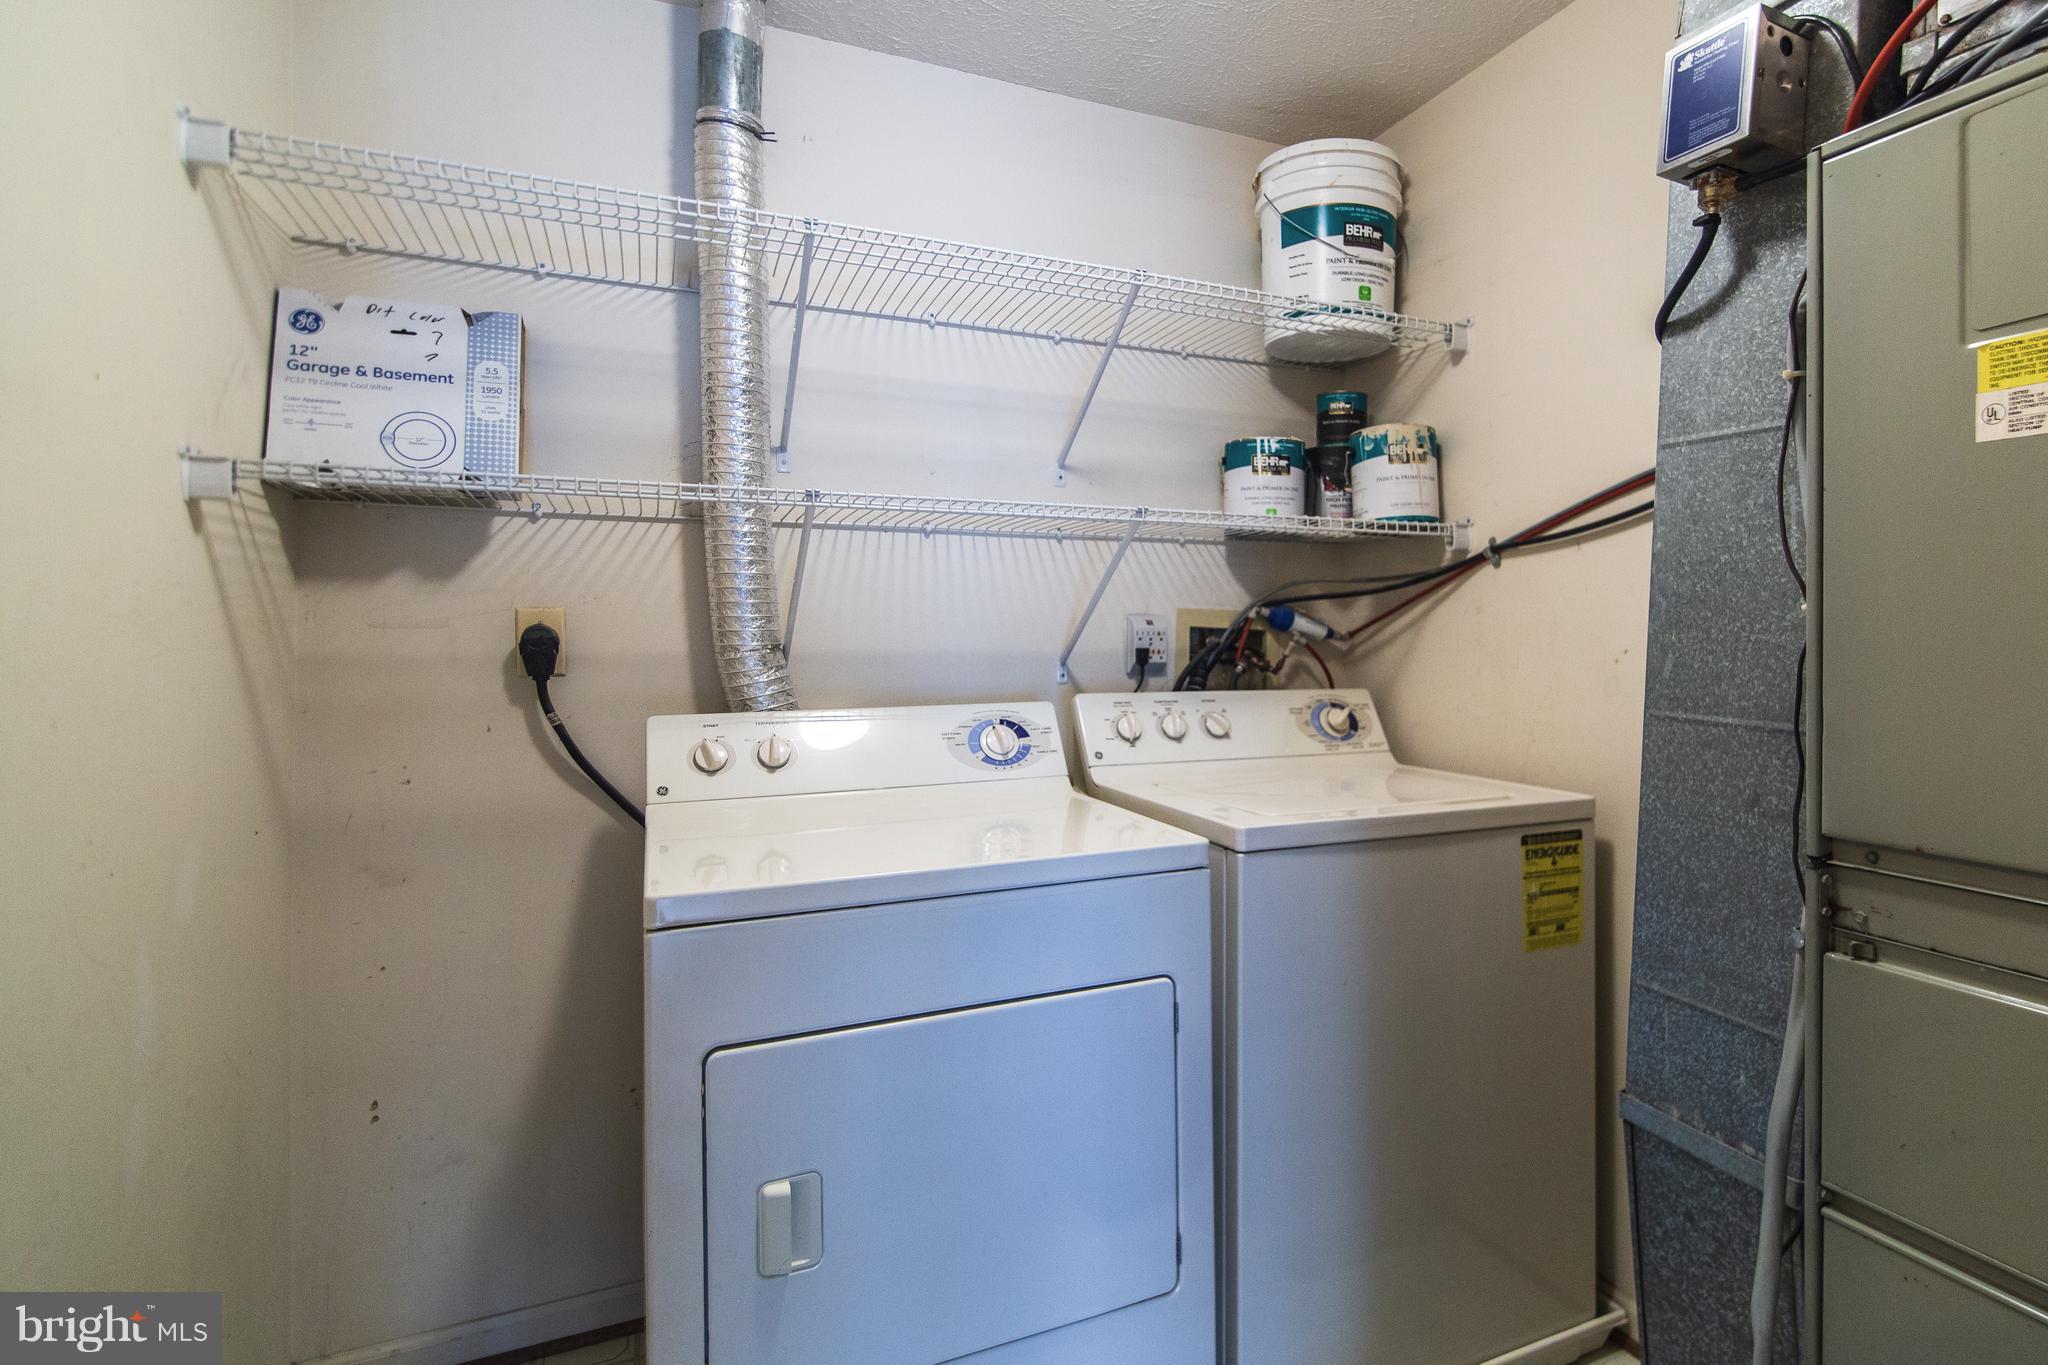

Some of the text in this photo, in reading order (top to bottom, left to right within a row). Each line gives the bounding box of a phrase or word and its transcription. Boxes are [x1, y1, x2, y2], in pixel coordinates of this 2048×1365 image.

[1694, 38, 1726, 60] Skuttle
[1345, 223, 1373, 238] BEHR
[1326, 257, 1347, 265] PAINT
[1990, 347, 2016, 357] ELECTRIC
[286, 359, 455, 385] Garage & Basement
[485, 367, 499, 375] 5.5
[350, 381, 369, 389] Cool
[370, 383, 393, 391] White
[481, 386, 503, 395] 1950
[2009, 393, 2035, 401] SECTION
[1986, 407, 2001, 421] UL
[2008, 420, 2034, 428] SECTION
